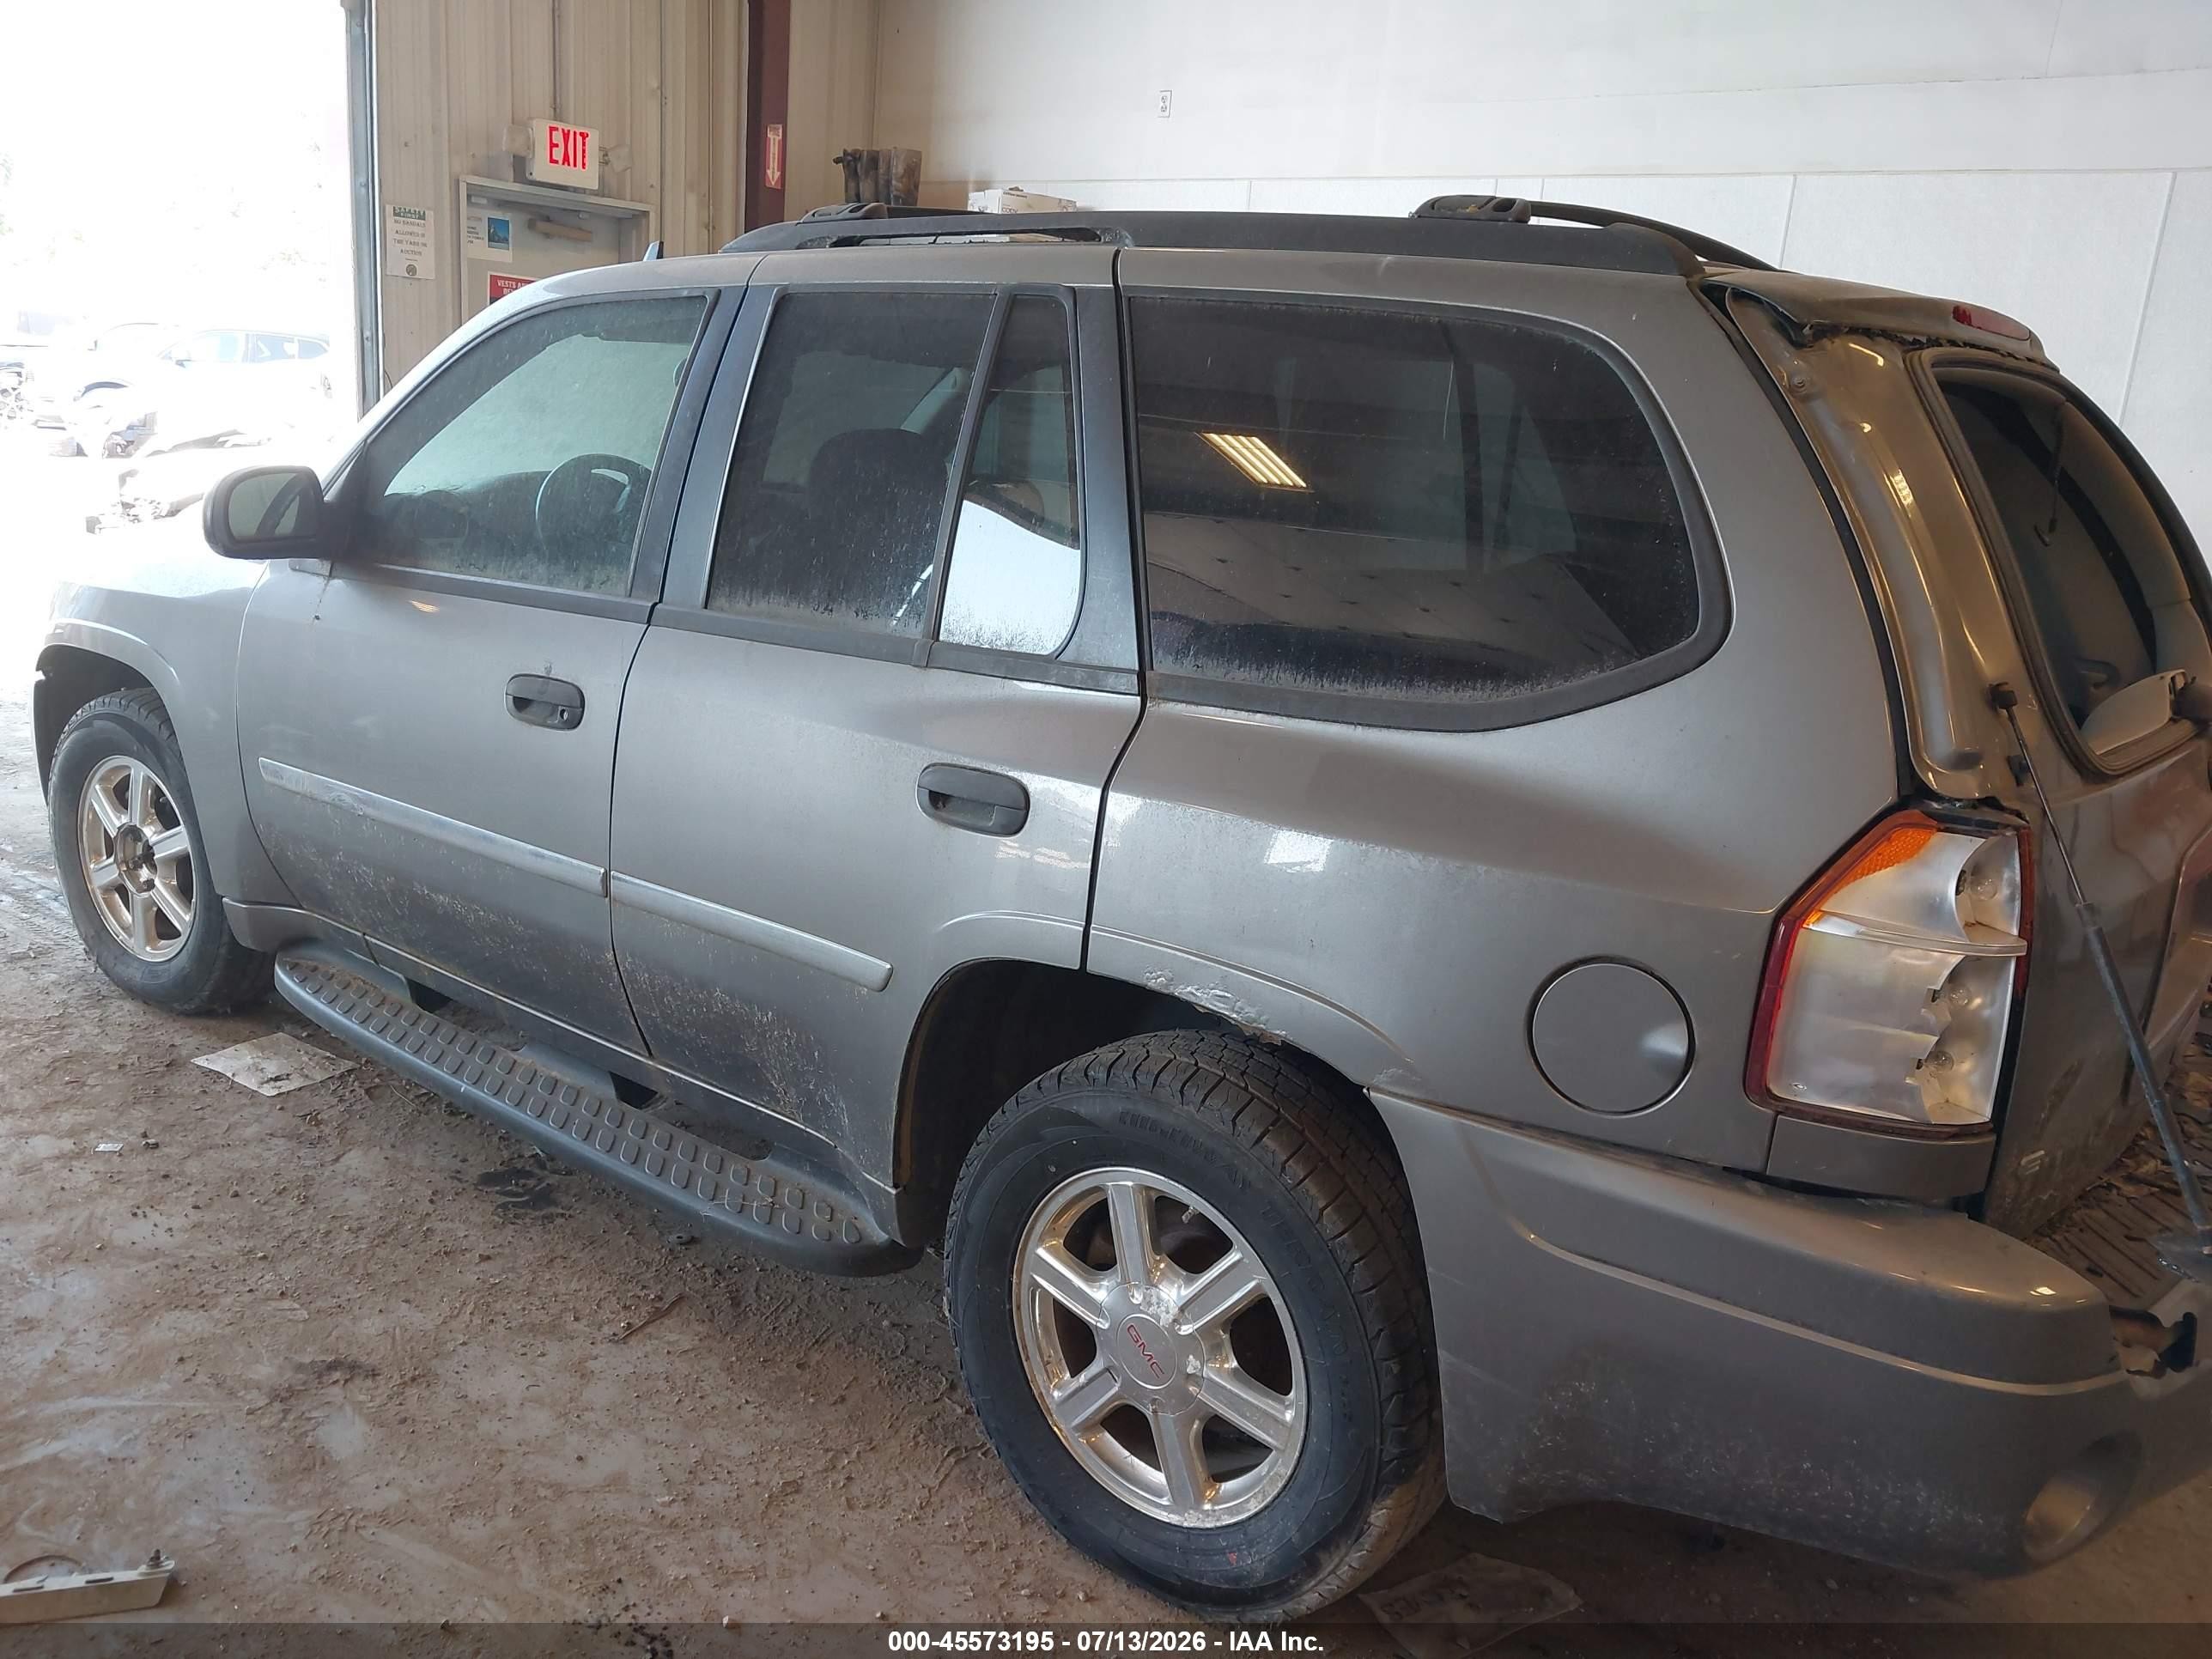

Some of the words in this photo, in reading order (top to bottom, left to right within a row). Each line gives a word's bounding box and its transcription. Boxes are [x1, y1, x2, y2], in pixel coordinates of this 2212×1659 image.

[548, 125, 589, 170] EXIT
[497, 279, 516, 289] VESTS
[1127, 1324, 1164, 1379] GMC
